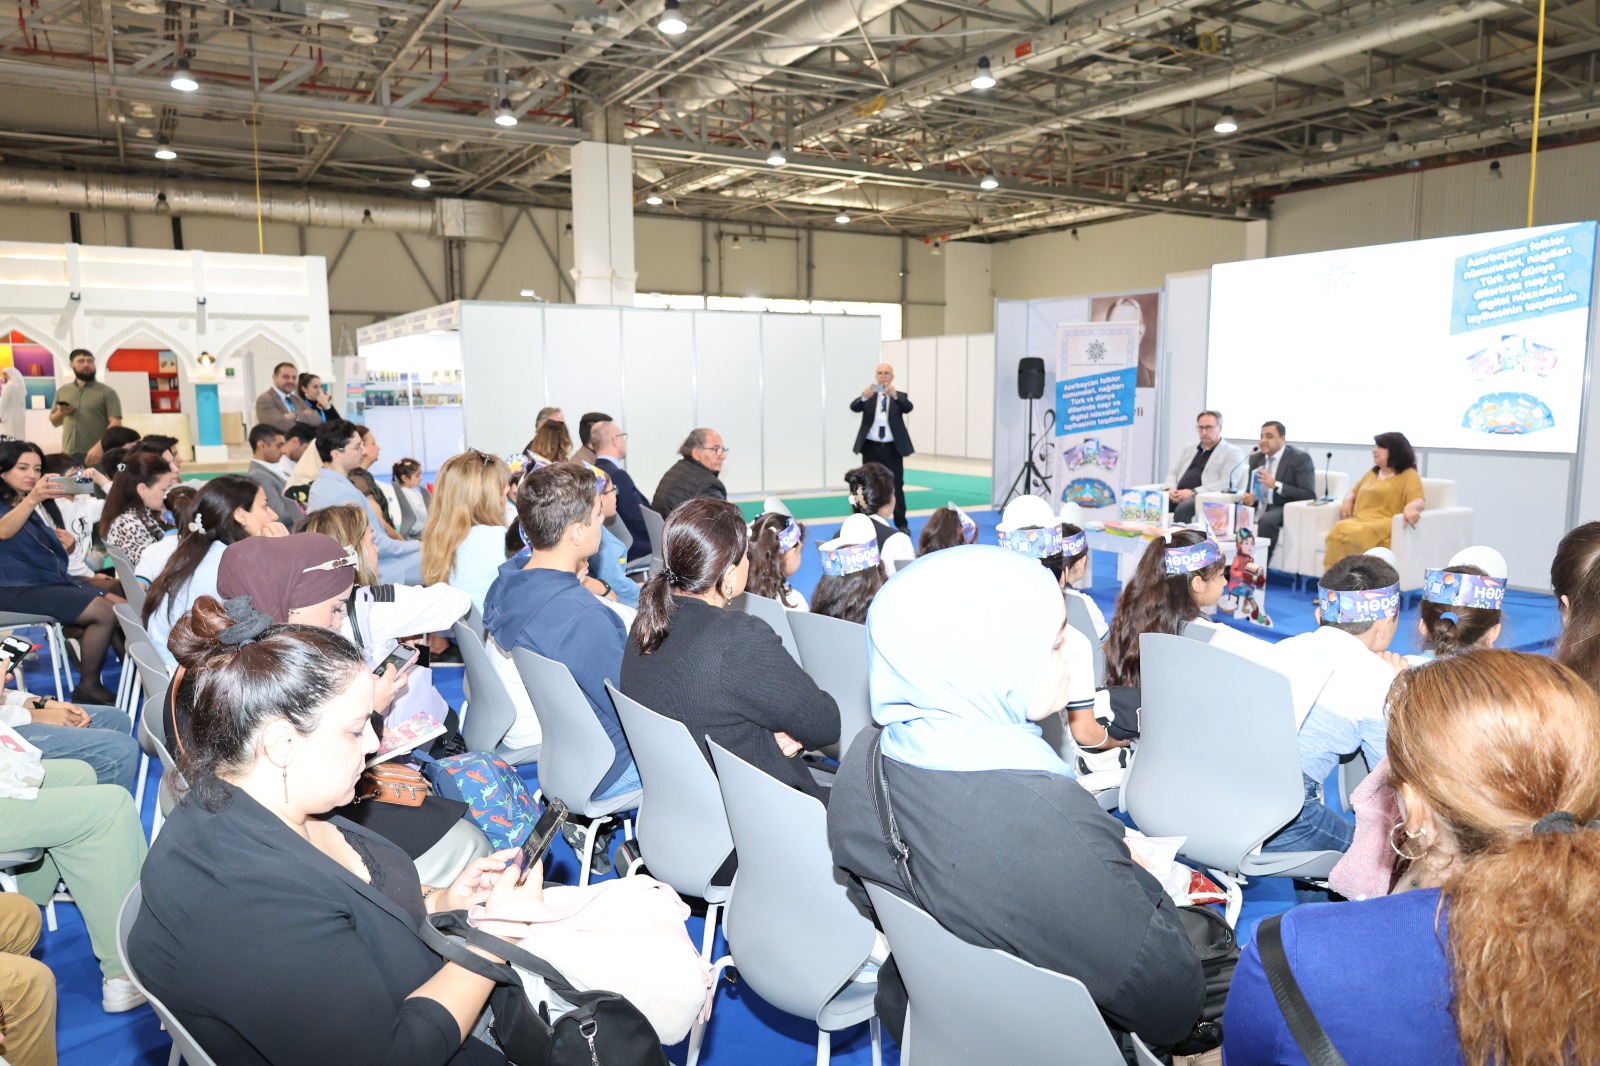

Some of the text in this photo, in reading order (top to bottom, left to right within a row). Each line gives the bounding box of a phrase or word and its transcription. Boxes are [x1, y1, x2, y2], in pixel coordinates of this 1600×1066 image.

[1529, 235, 1566, 252] folklor
[1479, 273, 1504, 287] Türk
[1521, 262, 1556, 277] dünya
[1099, 375, 1121, 384] folklor
[1095, 393, 1115, 402] dünya
